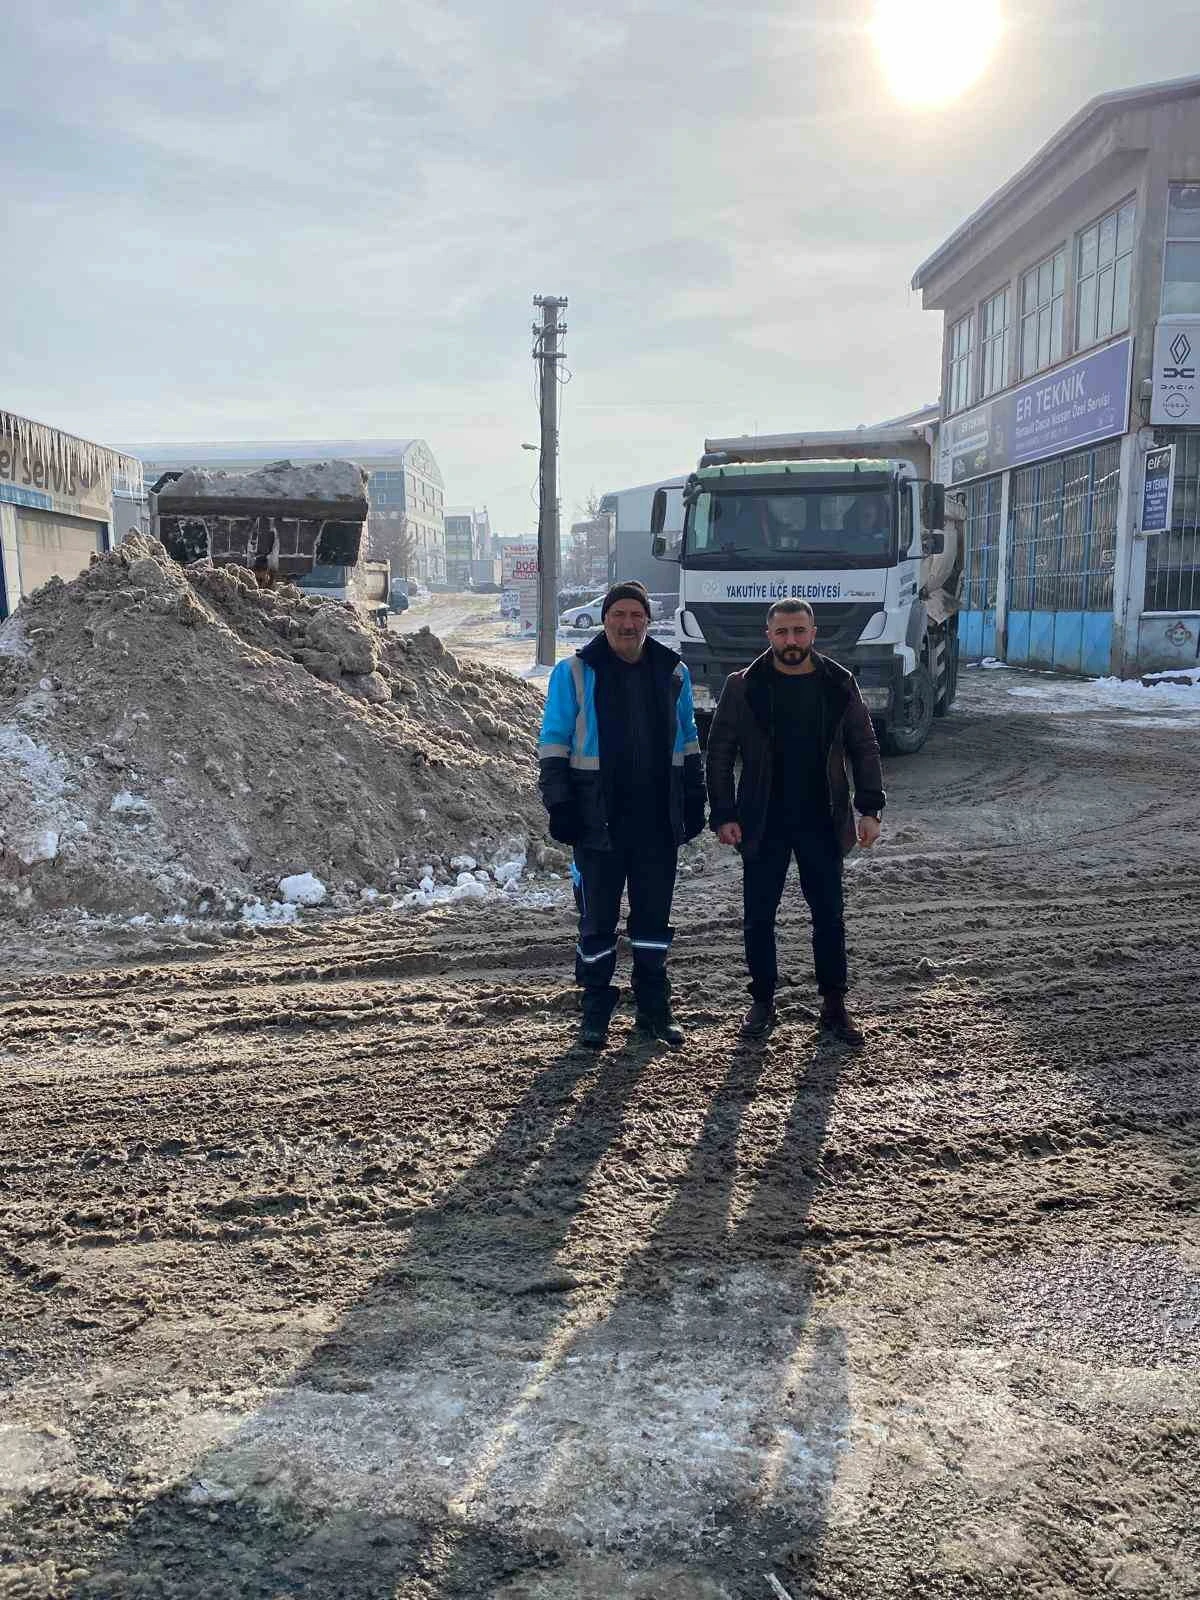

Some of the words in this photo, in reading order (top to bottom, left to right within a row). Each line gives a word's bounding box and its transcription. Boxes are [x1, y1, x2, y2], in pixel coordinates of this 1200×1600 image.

[1017, 396, 1032, 422] ER
[1035, 370, 1086, 414] TEKNİK
[1147, 455, 1162, 470] elf
[726, 582, 767, 598] YAKUTİYE
[770, 582, 788, 599] İLÇE
[791, 582, 841, 599] BELEDİYESİ
